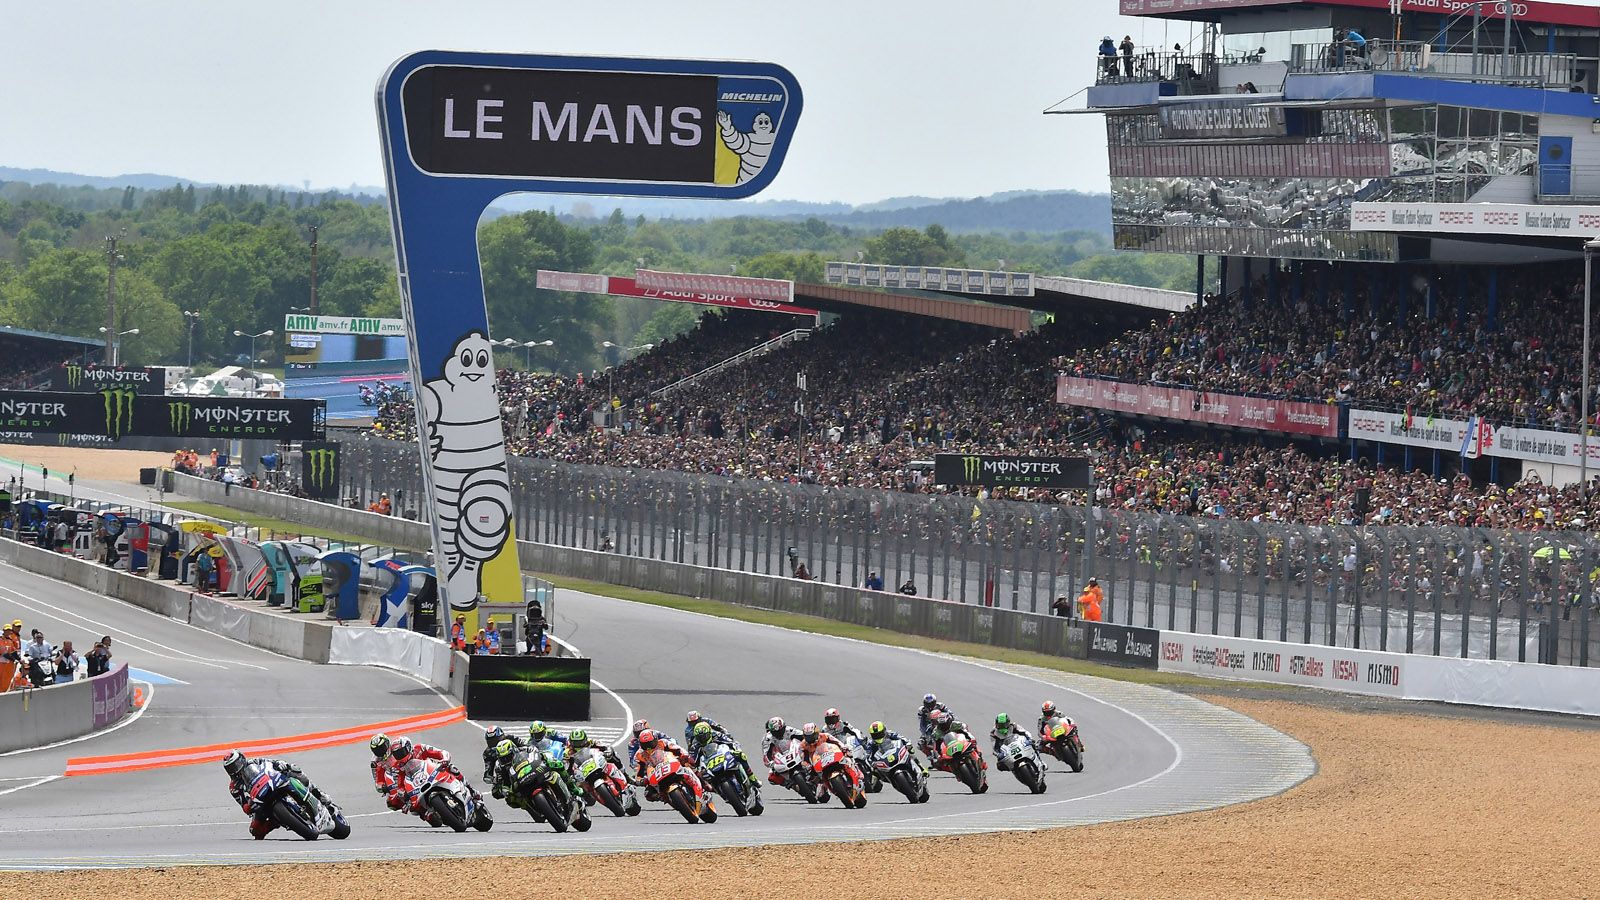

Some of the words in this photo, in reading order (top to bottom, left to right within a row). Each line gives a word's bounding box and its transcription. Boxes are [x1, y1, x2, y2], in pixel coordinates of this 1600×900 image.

[721, 93, 782, 102] MICHELIN
[444, 99, 504, 139] LE
[531, 101, 702, 147] MANS
[1171, 109, 1213, 131] AUTOMOBILE
[1214, 108, 1232, 129] CLUB
[1232, 108, 1242, 129] DE
[1243, 107, 1271, 129] L'OUEST
[1355, 210, 1386, 223] PORSCHE
[1439, 211, 1474, 224] PORSCHE
[1484, 212, 1518, 225] PORSCHE
[319, 320, 348, 330] amv.fr
[381, 323, 406, 332] amv.
[84, 369, 150, 382] MONSTER
[194, 405, 292, 424] MONSTER
[209, 425, 278, 434] ENERGY
[1354, 418, 1385, 433] PORSCHE
[984, 459, 1062, 475] MONSTER
[421, 601, 434, 610] sky
[1161, 641, 1184, 663] NISSAN
[1289, 655, 1324, 678] #GTRLeMans
[1332, 659, 1358, 681] NISSAN
[707, 754, 725, 769] 46
[655, 763, 671, 780] 93
